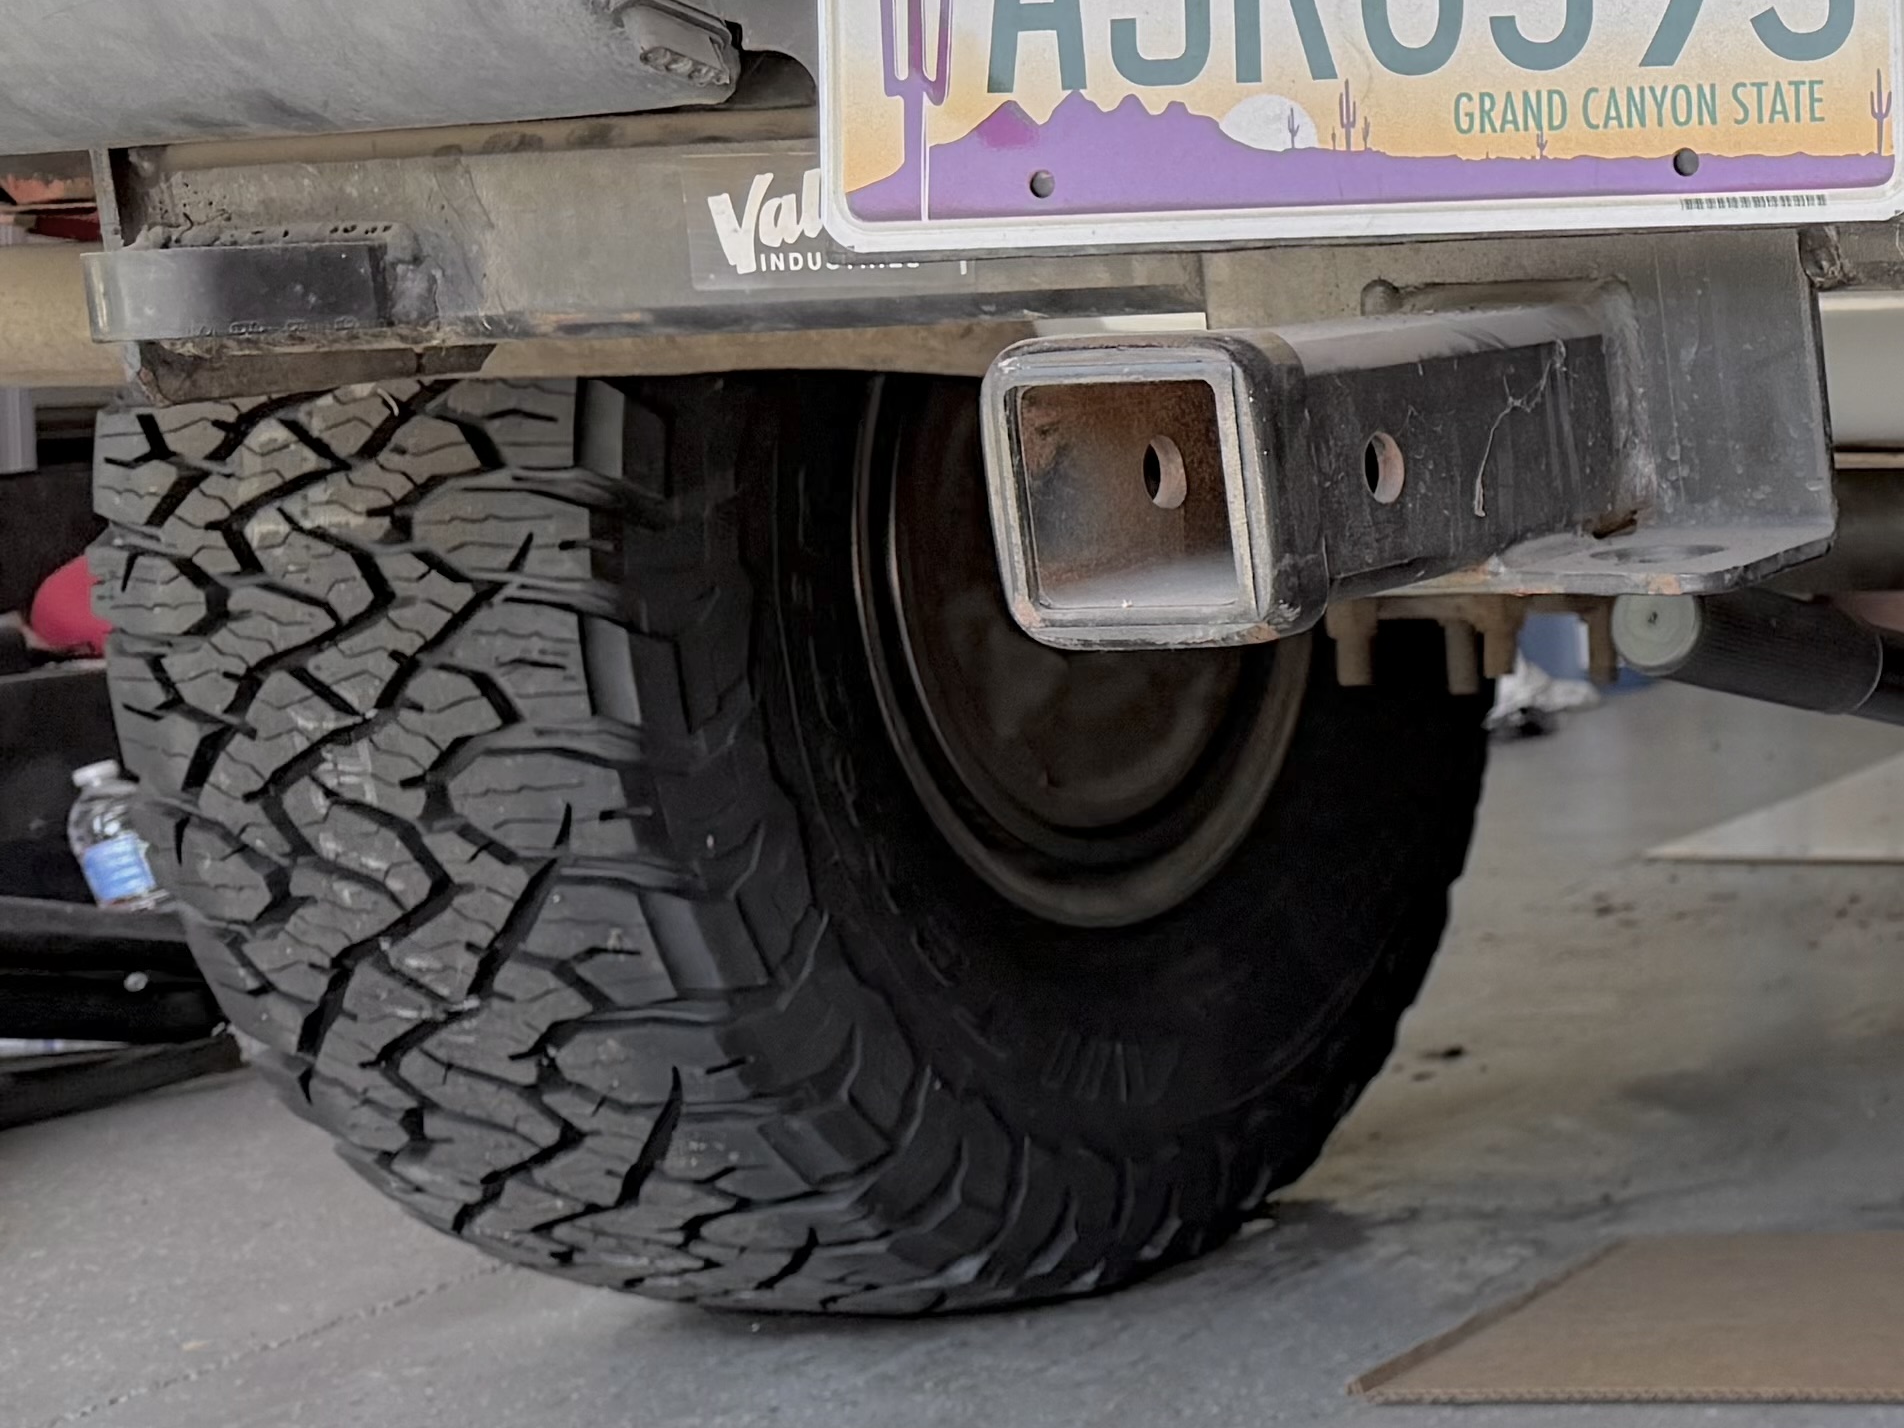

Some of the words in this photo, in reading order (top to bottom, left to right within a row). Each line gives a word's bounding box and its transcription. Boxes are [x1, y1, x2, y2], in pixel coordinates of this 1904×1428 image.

[1452, 88, 1569, 135] GRAND
[1581, 82, 1718, 131] CANYON
[1731, 79, 1826, 126] STATE
[708, 168, 823, 274] Val
